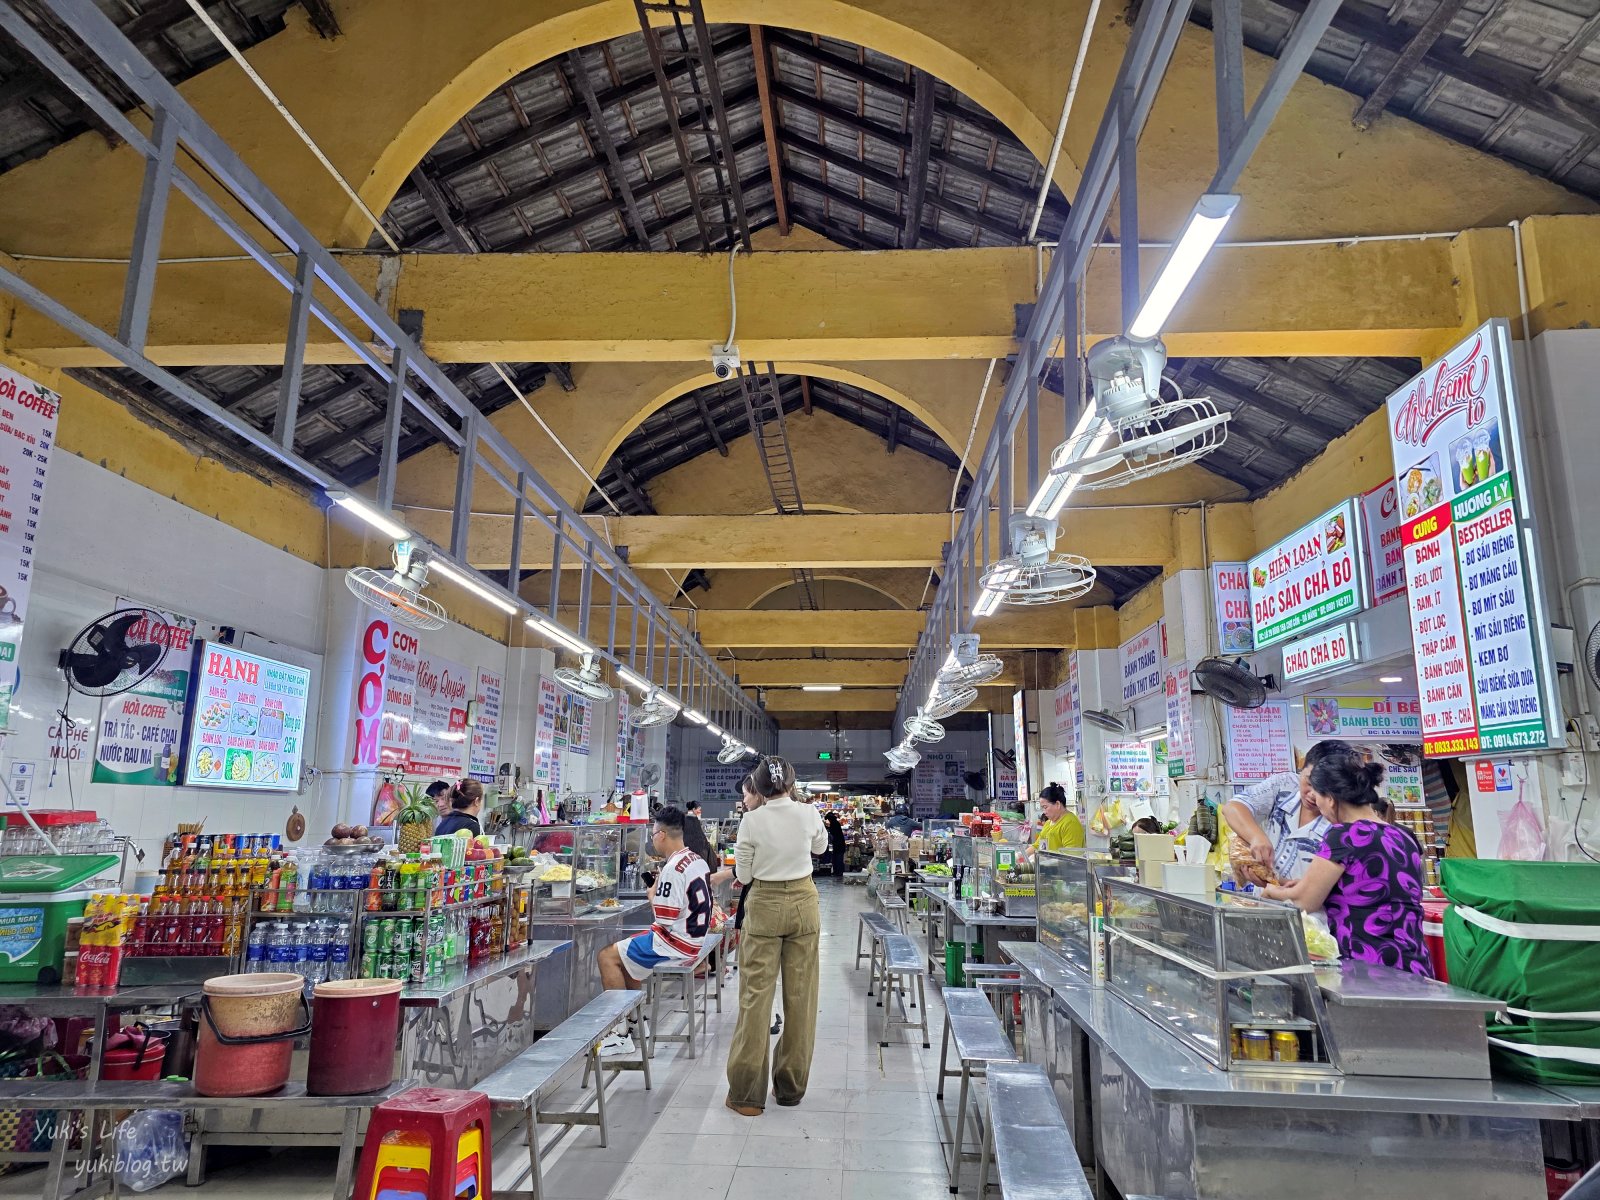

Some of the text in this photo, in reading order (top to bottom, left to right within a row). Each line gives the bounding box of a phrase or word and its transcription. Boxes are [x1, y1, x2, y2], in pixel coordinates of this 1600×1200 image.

[1394, 333, 1489, 446] Welcome
[18, 390, 56, 419] COFFEE
[1466, 396, 1485, 429] to
[42, 428, 52, 438] 15K
[36, 467, 45, 477] 15K
[31, 493, 41, 502] 15K
[1493, 478, 1509, 502] LÝ
[29, 506, 39, 516] 15K
[27, 519, 37, 529] 15K
[1412, 516, 1438, 540] CUNG
[1458, 508, 1514, 547] BESTSELLER
[24, 532, 34, 542] 15K
[22, 546, 32, 555] 15K
[1268, 534, 1322, 582] HIỀN LOAN
[1415, 540, 1441, 565] BÁNH
[1466, 550, 1476, 566] BƠ
[1492, 534, 1514, 555] RIÊNG
[20, 559, 30, 568] 15K
[18, 572, 28, 582] 15K
[1468, 576, 1478, 591] BƠ
[1254, 552, 1352, 626] ĐẶC SẢN CHẢ BÒ
[1472, 600, 1482, 616] BƠ
[1483, 594, 1498, 612] MÍT
[1419, 613, 1447, 636] BỘT LỌC
[1474, 624, 1487, 642] MÍT
[1503, 613, 1526, 634] RIÊNG
[1285, 632, 1346, 674] CHÁO CHẢ BÒ
[1421, 638, 1439, 658] THẬP
[1477, 646, 1509, 666] KEM BƠ
[208, 652, 260, 685] HẠNH
[1125, 650, 1156, 678] BÁNH TRÁNG
[1424, 657, 1464, 680] BÁNH CUỐN
[416, 660, 438, 698] Hồng
[440, 669, 466, 702] Quyên
[1137, 677, 1148, 694] THỊT
[1149, 670, 1159, 688] HEO
[352, 620, 389, 765] CƠM
[1427, 684, 1445, 704] BÁNH
[122, 698, 168, 719] HOÀ COFFEE
[1424, 712, 1438, 729] NEM
[1458, 702, 1472, 724] CHẢ
[1520, 696, 1538, 716] RIÊNG
[1342, 715, 1368, 726] BÁNH
[1372, 715, 1390, 726] BÈO
[66, 728, 89, 742] PHÊ
[104, 720, 117, 737] TRÀ
[142, 724, 159, 743] CAFÉ
[161, 729, 178, 744] CHAI
[1494, 730, 1546, 748] 0914.673.272
[50, 743, 81, 760] MUỐI
[124, 746, 139, 764] RAU
[140, 747, 152, 765] MÁ
[284, 736, 297, 753] 25K
